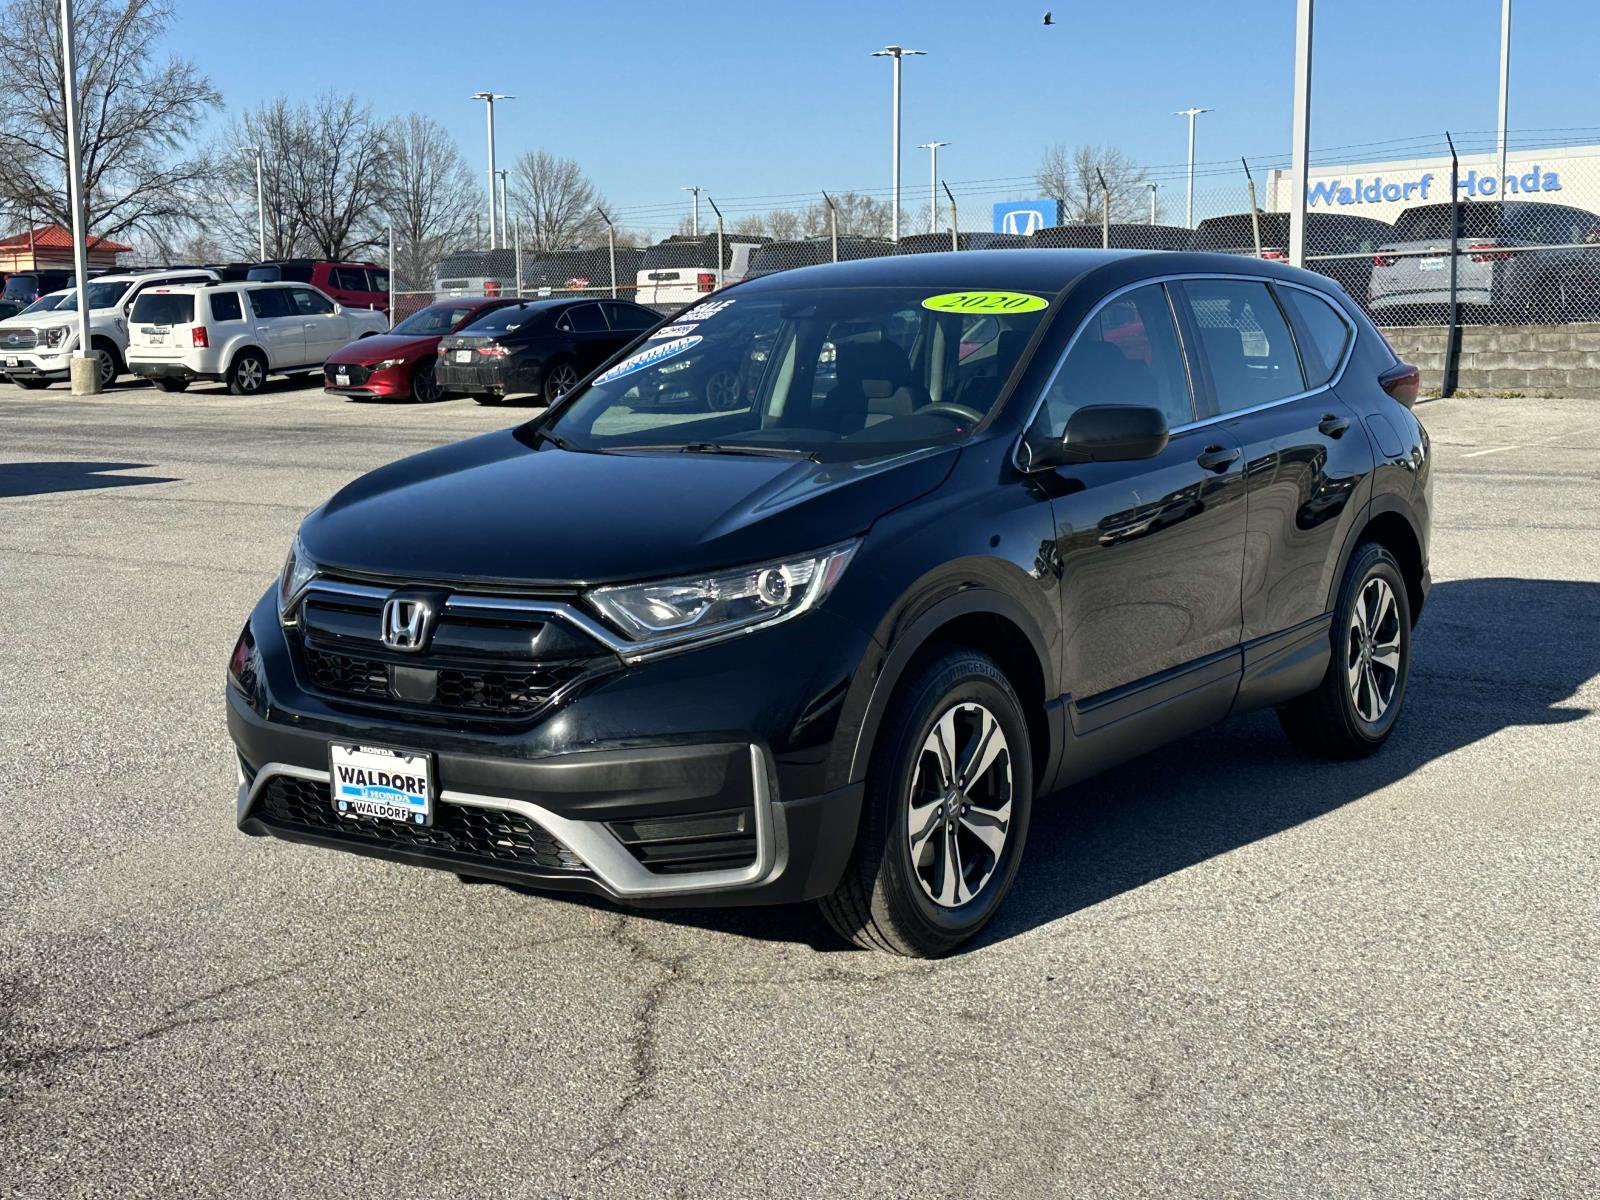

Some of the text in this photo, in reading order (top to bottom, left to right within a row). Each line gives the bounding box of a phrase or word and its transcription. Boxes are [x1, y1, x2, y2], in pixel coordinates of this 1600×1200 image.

[1308, 165, 1562, 207] Waldorf Honda
[940, 296, 1030, 308] 2020
[359, 746, 395, 757] HONDA
[337, 765, 426, 795] WALDORF
[370, 790, 409, 803] HONDA
[356, 801, 407, 819] WALDORF
